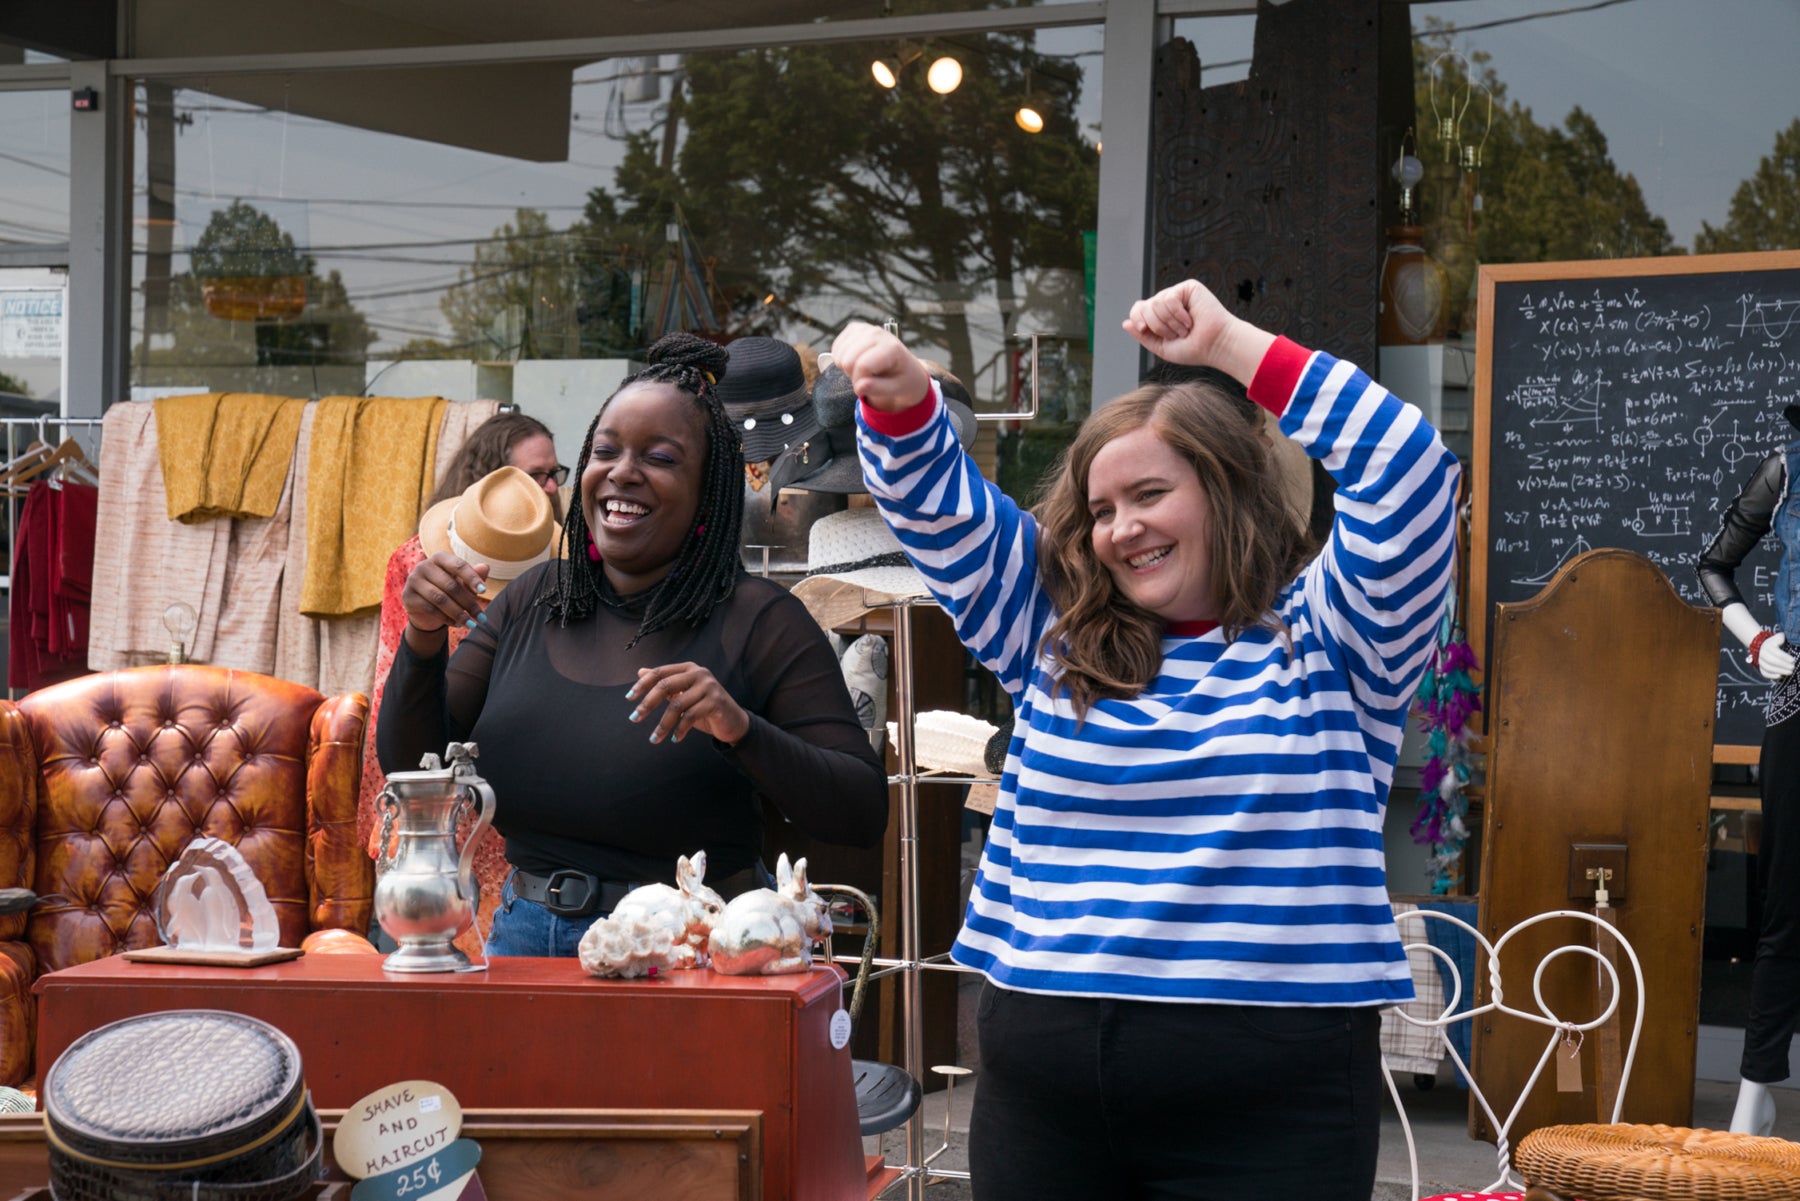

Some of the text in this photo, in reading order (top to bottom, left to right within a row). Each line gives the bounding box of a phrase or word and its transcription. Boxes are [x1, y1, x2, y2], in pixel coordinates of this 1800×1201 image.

[5, 300, 59, 315] NOTICE
[362, 1088, 415, 1122] SHAVE
[379, 1117, 418, 1135] AND
[366, 1127, 448, 1174] HAIRCUT
[396, 1157, 442, 1197] 25¢
